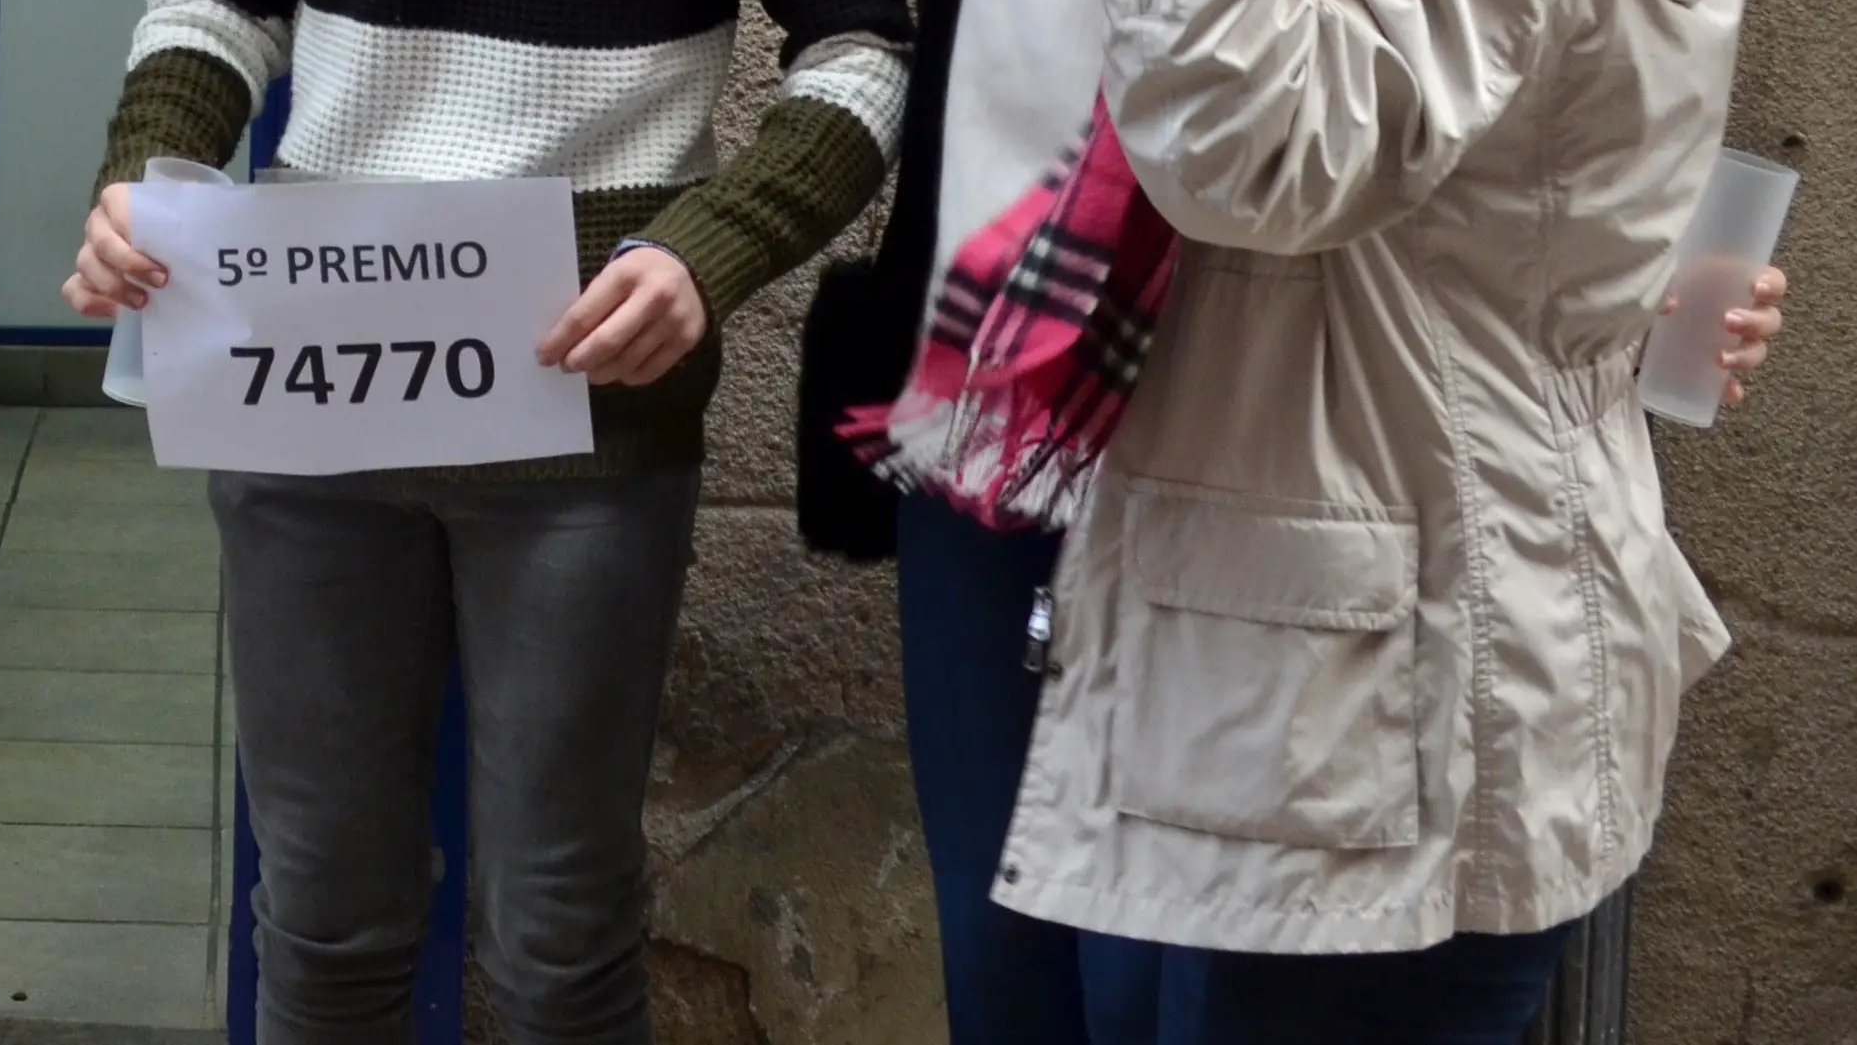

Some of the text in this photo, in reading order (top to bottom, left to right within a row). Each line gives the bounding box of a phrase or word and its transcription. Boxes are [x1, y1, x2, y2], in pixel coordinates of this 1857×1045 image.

[217, 240, 489, 287] 5º PREMIO
[230, 337, 496, 407] 74770
